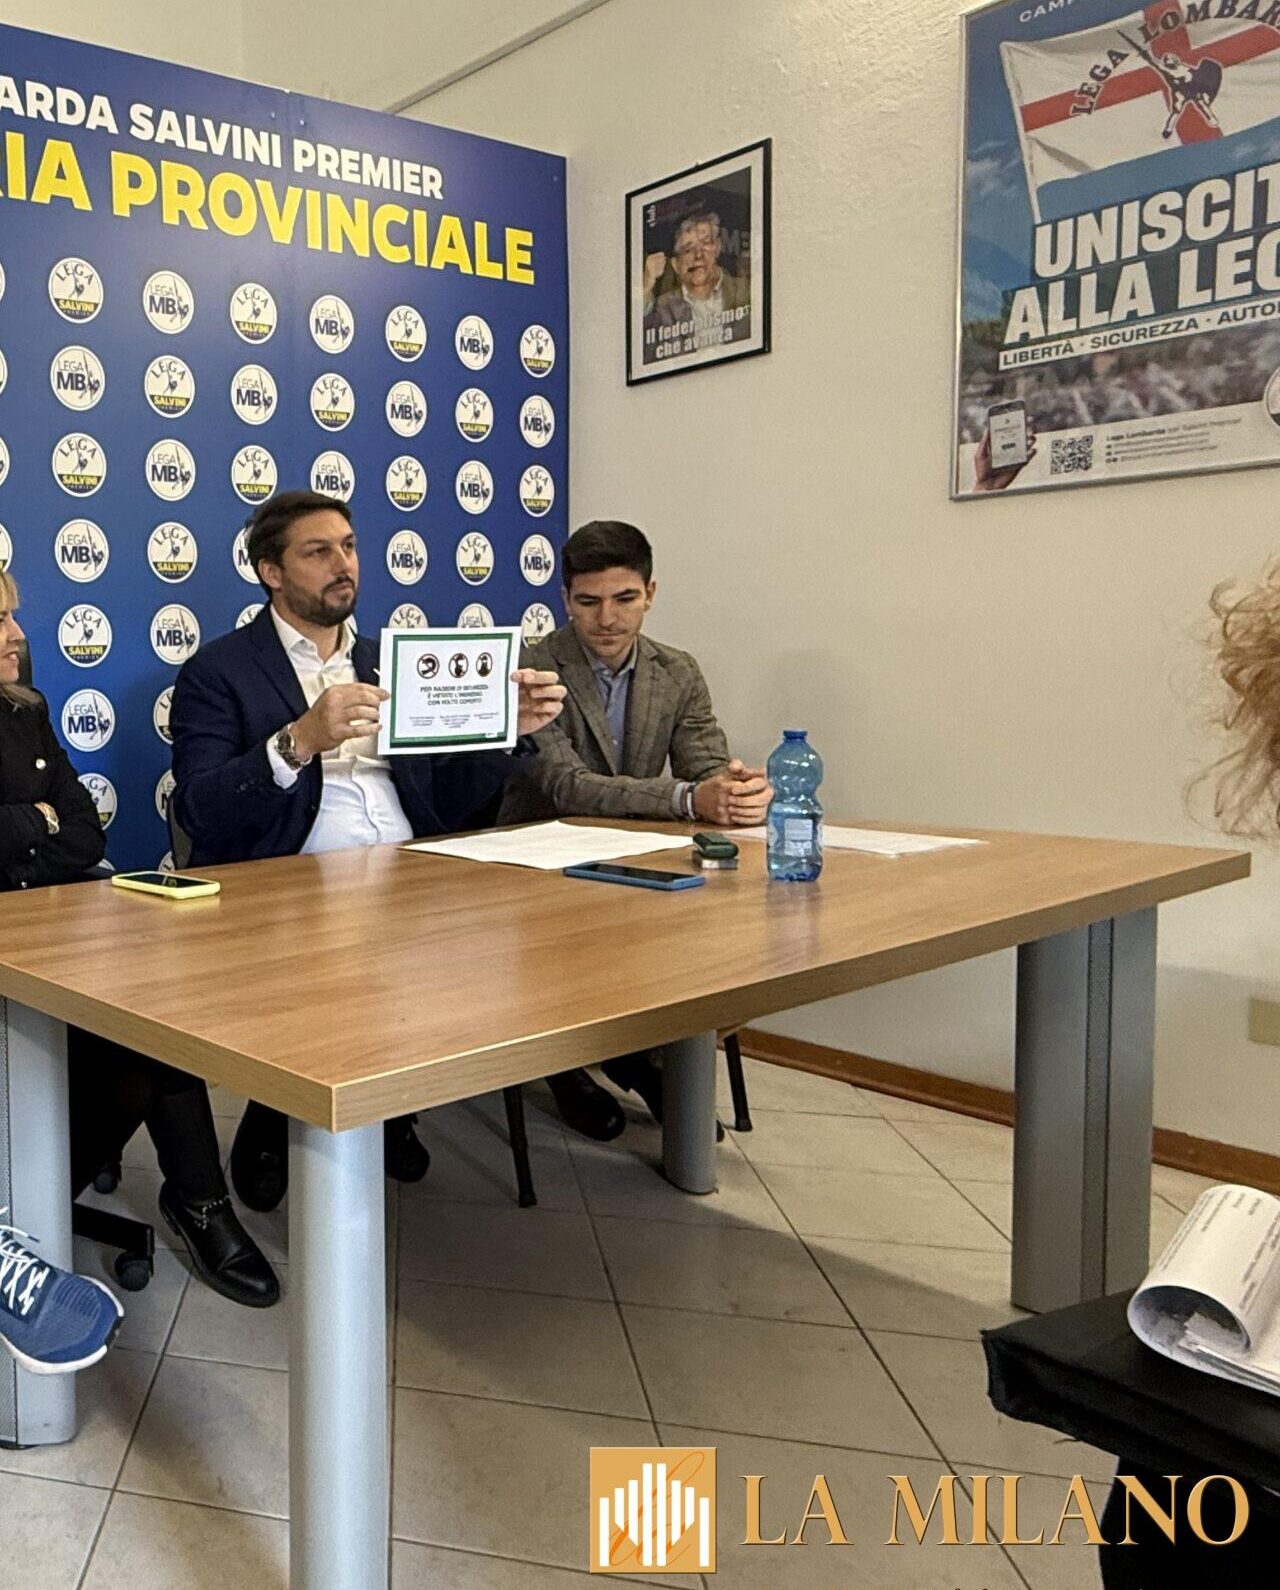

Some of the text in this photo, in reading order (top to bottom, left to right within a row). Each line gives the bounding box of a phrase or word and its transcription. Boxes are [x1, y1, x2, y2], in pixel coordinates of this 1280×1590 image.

[1020, 0, 1072, 22] CAM
[1071, 49, 1129, 116] LEGA
[129, 105, 282, 169] SALVINI
[294, 139, 443, 200] PREMIER
[110, 150, 535, 285] PROVINCIALE
[56, 264, 93, 285] LEGA
[59, 300, 94, 312] SALVINI
[149, 295, 176, 315] MB
[1004, 261, 1155, 345] ALLA
[315, 318, 338, 336] MB
[1003, 300, 1280, 366] LIBERTÀ SICUREZZA AUTO
[460, 337, 480, 354] MB
[656, 340, 681, 358] che
[57, 371, 86, 391] MB
[154, 396, 186, 406] SALVINI
[236, 388, 261, 406] MB
[391, 403, 412, 420] MB
[524, 416, 542, 432] MB
[60, 439, 97, 459] LEGA
[63, 475, 97, 485] SALVINI
[151, 464, 178, 482] MB
[317, 475, 340, 491] MB
[460, 482, 480, 497] MB
[61, 546, 90, 563] MB
[392, 553, 413, 568] MB
[524, 556, 542, 570] MB
[157, 563, 189, 571] SALVINI
[66, 610, 102, 629] LEGA
[156, 629, 183, 646] MB
[69, 646, 103, 655] SALVINI
[68, 715, 96, 733] MB
